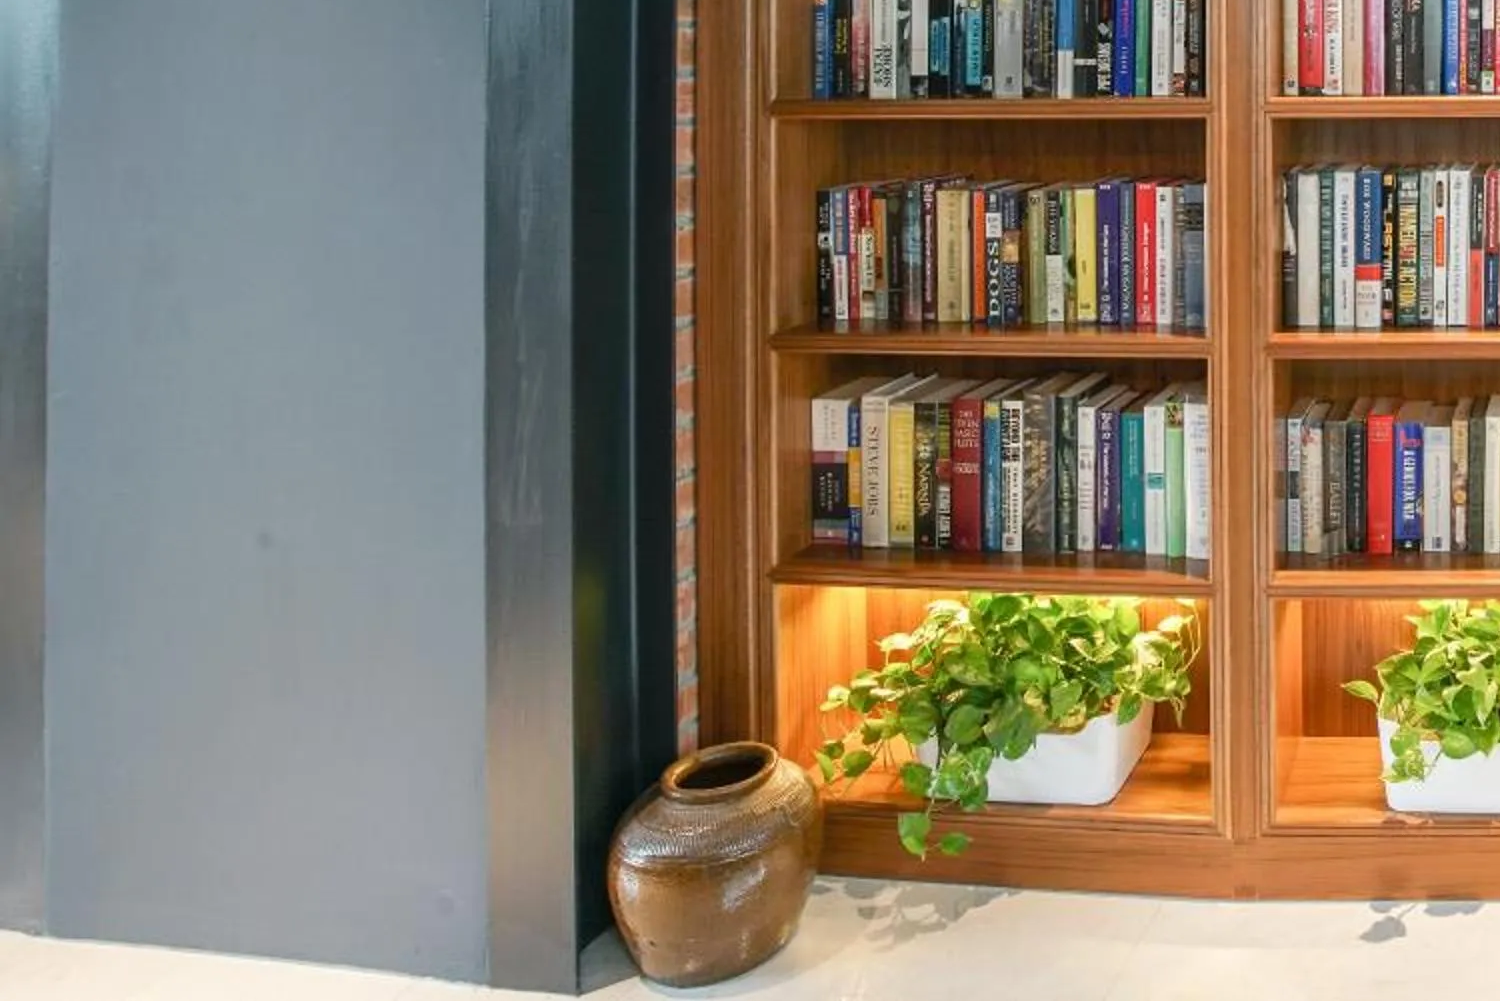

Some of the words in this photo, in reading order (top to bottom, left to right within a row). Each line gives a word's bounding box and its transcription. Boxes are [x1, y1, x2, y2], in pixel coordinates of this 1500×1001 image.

[988, 241, 1000, 316] DOGS
[867, 426, 881, 476] STEVE
[867, 479, 881, 517] JOBS
[1329, 482, 1340, 525] BALLET
